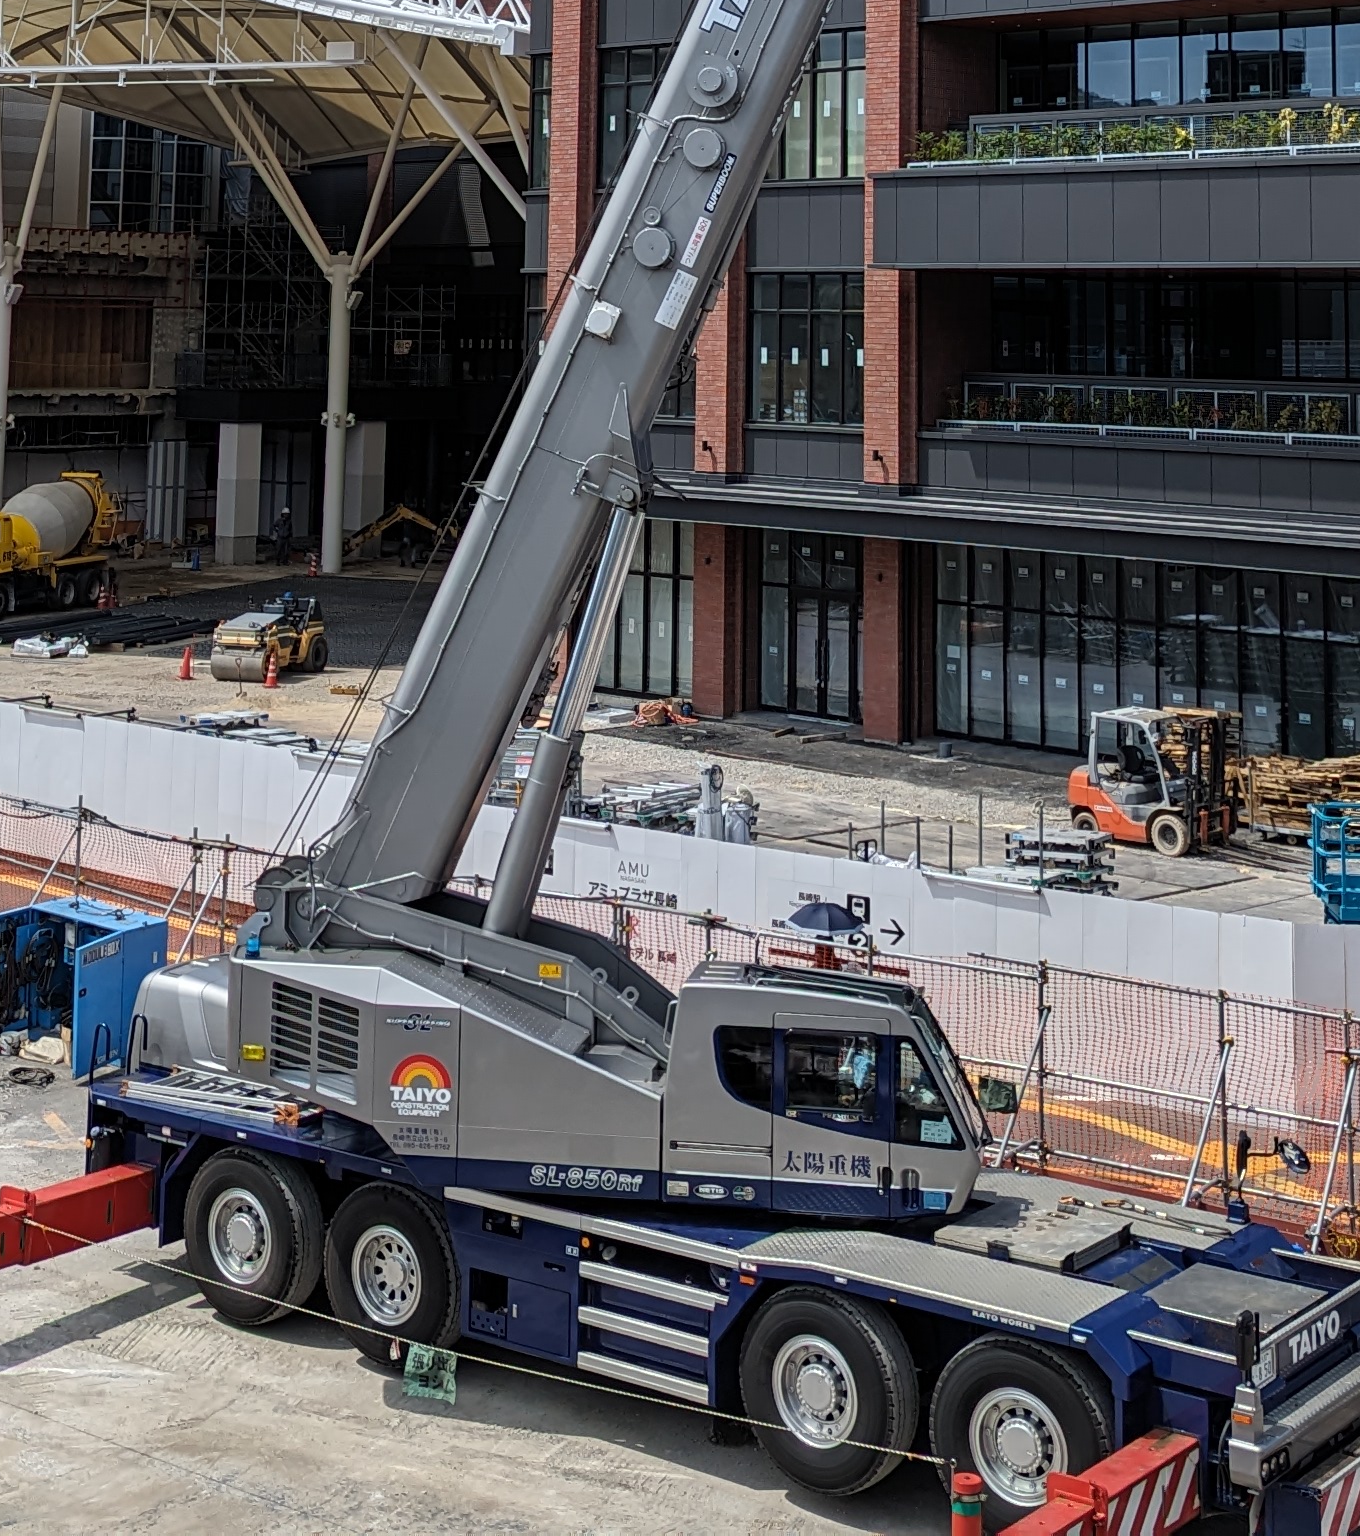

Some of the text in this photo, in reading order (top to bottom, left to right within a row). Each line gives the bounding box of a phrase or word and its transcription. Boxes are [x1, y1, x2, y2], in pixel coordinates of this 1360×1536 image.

[618, 860, 649, 878] AMU
[390, 1085, 452, 1104] TAIYO
[391, 1101, 450, 1112] CONSTRUCTION
[398, 1108, 441, 1118] EQUIPMENT
[780, 1150, 872, 1179] 太陽重機
[971, 1309, 1037, 1331] KATO WORKS
[1289, 1310, 1340, 1365] TAIYO
